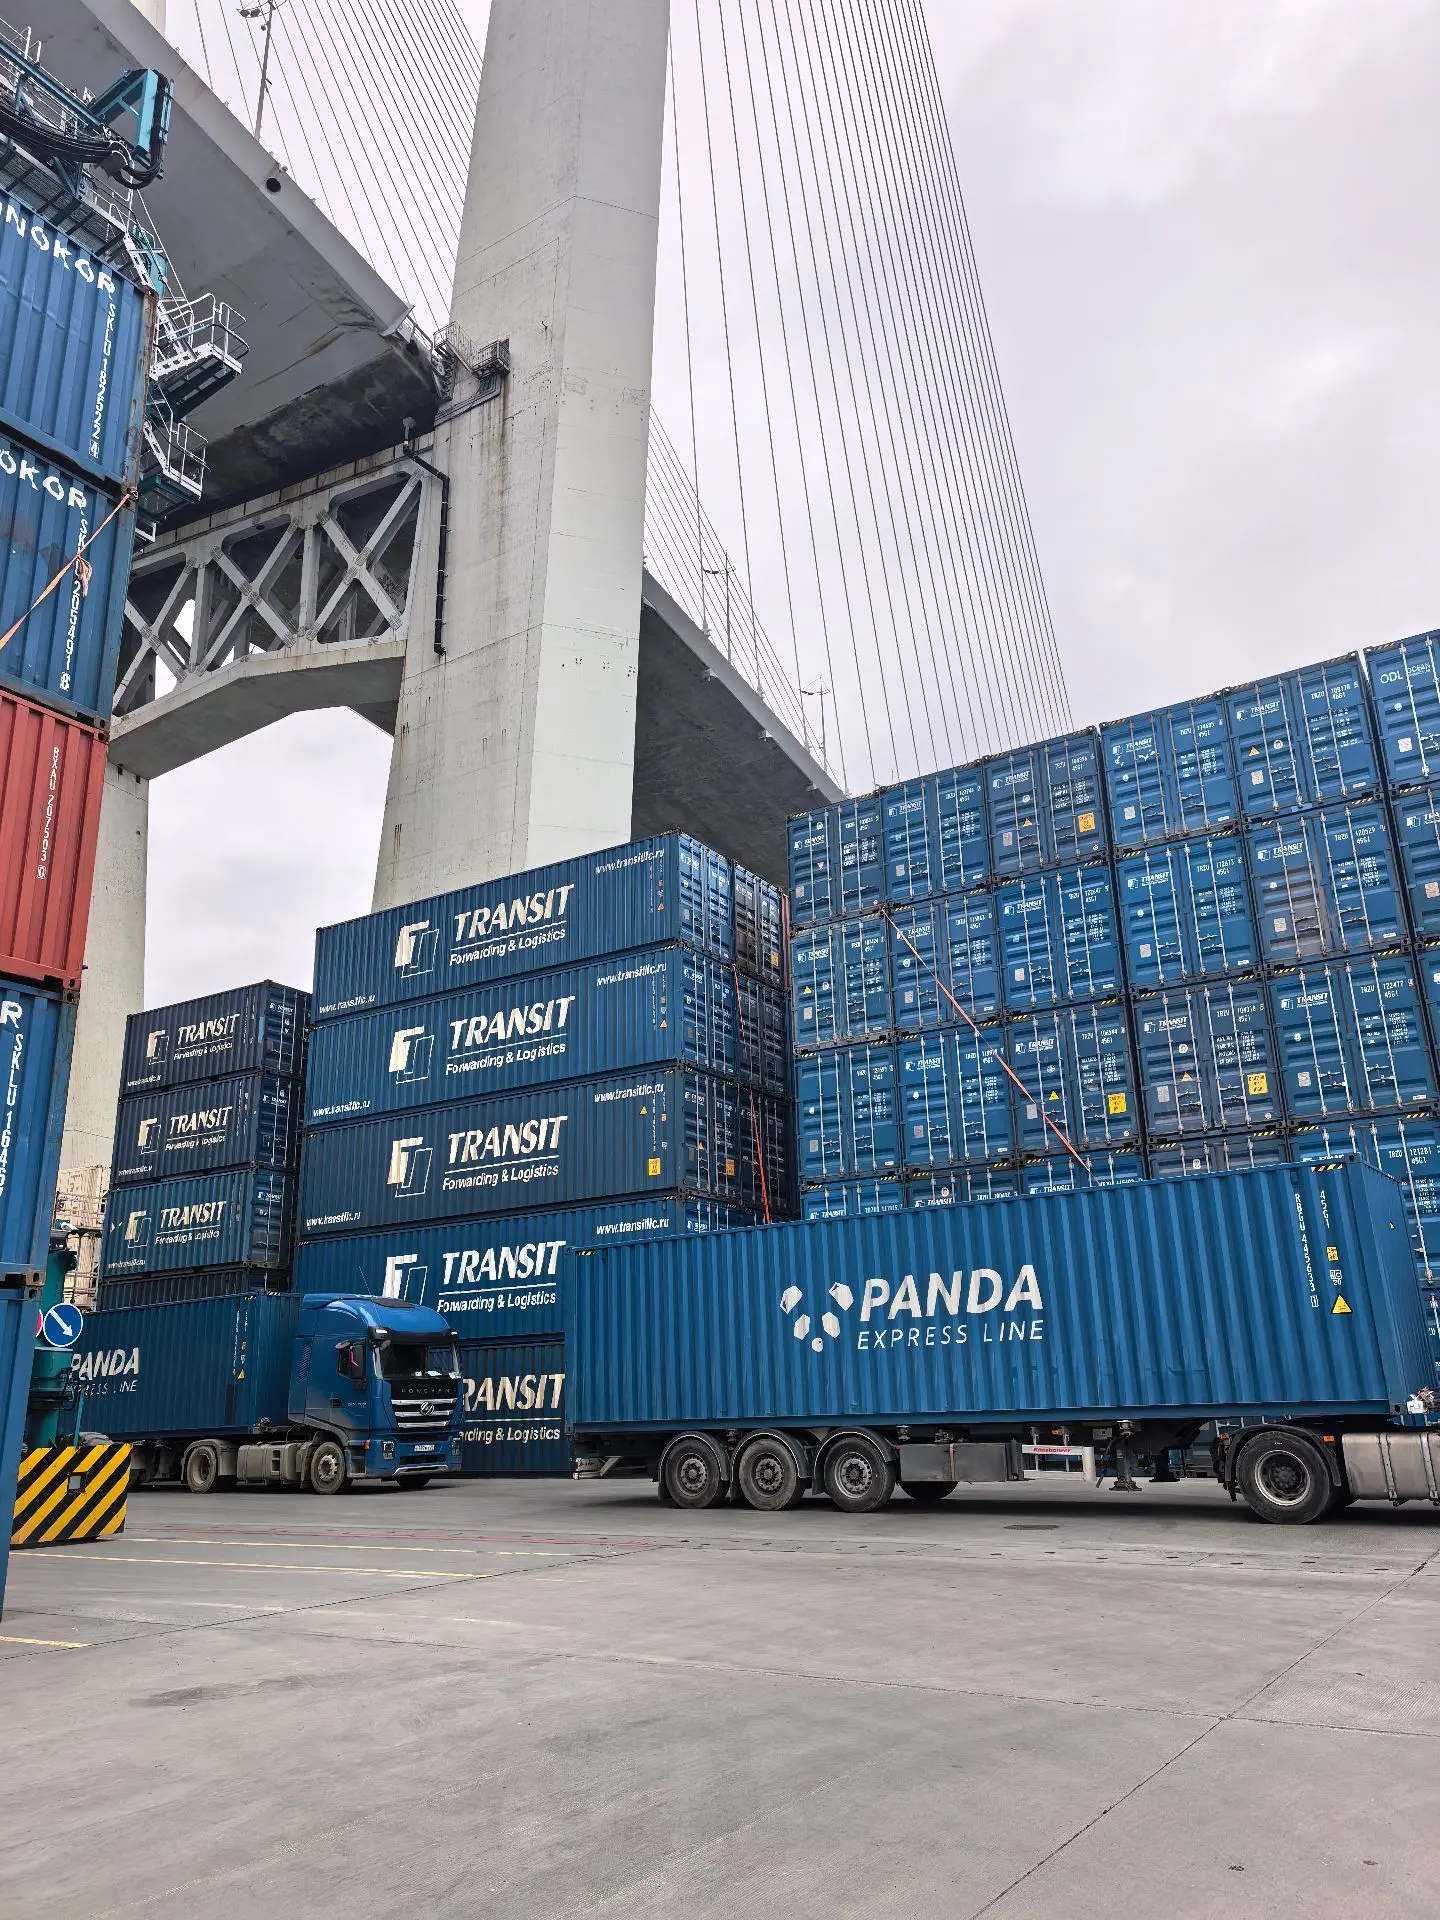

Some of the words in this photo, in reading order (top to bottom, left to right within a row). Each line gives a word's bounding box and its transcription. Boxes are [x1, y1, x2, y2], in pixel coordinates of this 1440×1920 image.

[92, 359, 107, 439] 182522
[89, 440, 99, 459] 4
[1380, 670, 1403, 684] ODL
[1251, 701, 1280, 713] TRANSIT
[1126, 738, 1152, 749] TRANSIT
[49, 747, 60, 791] BXAU
[41, 795, 54, 862] 207503
[1273, 842, 1303, 855] TRANSIT
[1141, 872, 1169, 882] TRANSIT
[454, 883, 575, 942] TRANSIT
[450, 942, 507, 966] Forwarding
[508, 940, 516, 952] &
[518, 928, 566, 951] Logistics
[1297, 993, 1328, 1003] TRANSIT
[177, 1013, 240, 1045] TRANSIT
[450, 996, 575, 1050] TRANSIT
[1159, 1017, 1187, 1026] TRANSIT
[7, 1034, 24, 1106] SKLU
[446, 1054, 504, 1076] Forwarding
[506, 1051, 514, 1064] &
[516, 1043, 566, 1062] Logistics
[170, 1106, 233, 1135] TRANSIT
[448, 1115, 568, 1164] TRANSIT
[443, 1171, 499, 1191] Forwarding
[502, 1170, 509, 1183] &
[511, 1164, 559, 1184] Logistics
[160, 1200, 227, 1229] TRANSIT
[1319, 1190, 1331, 1229] 45G1
[442, 1240, 567, 1285] TRANSIT
[1301, 1233, 1316, 1292] 445633
[437, 1296, 495, 1313] Forwarding
[498, 1294, 506, 1308] &
[508, 1291, 556, 1310] Logistics
[860, 1264, 1044, 1322] PANDA
[857, 1325, 968, 1350] EXPRESS
[984, 1320, 1045, 1343] LINE
[69, 1347, 140, 1381] PANDA
[462, 1373, 566, 1412] RANSIT
[459, 1429, 492, 1445] arding
[495, 1427, 504, 1441] &
[506, 1426, 561, 1444] Logistics
